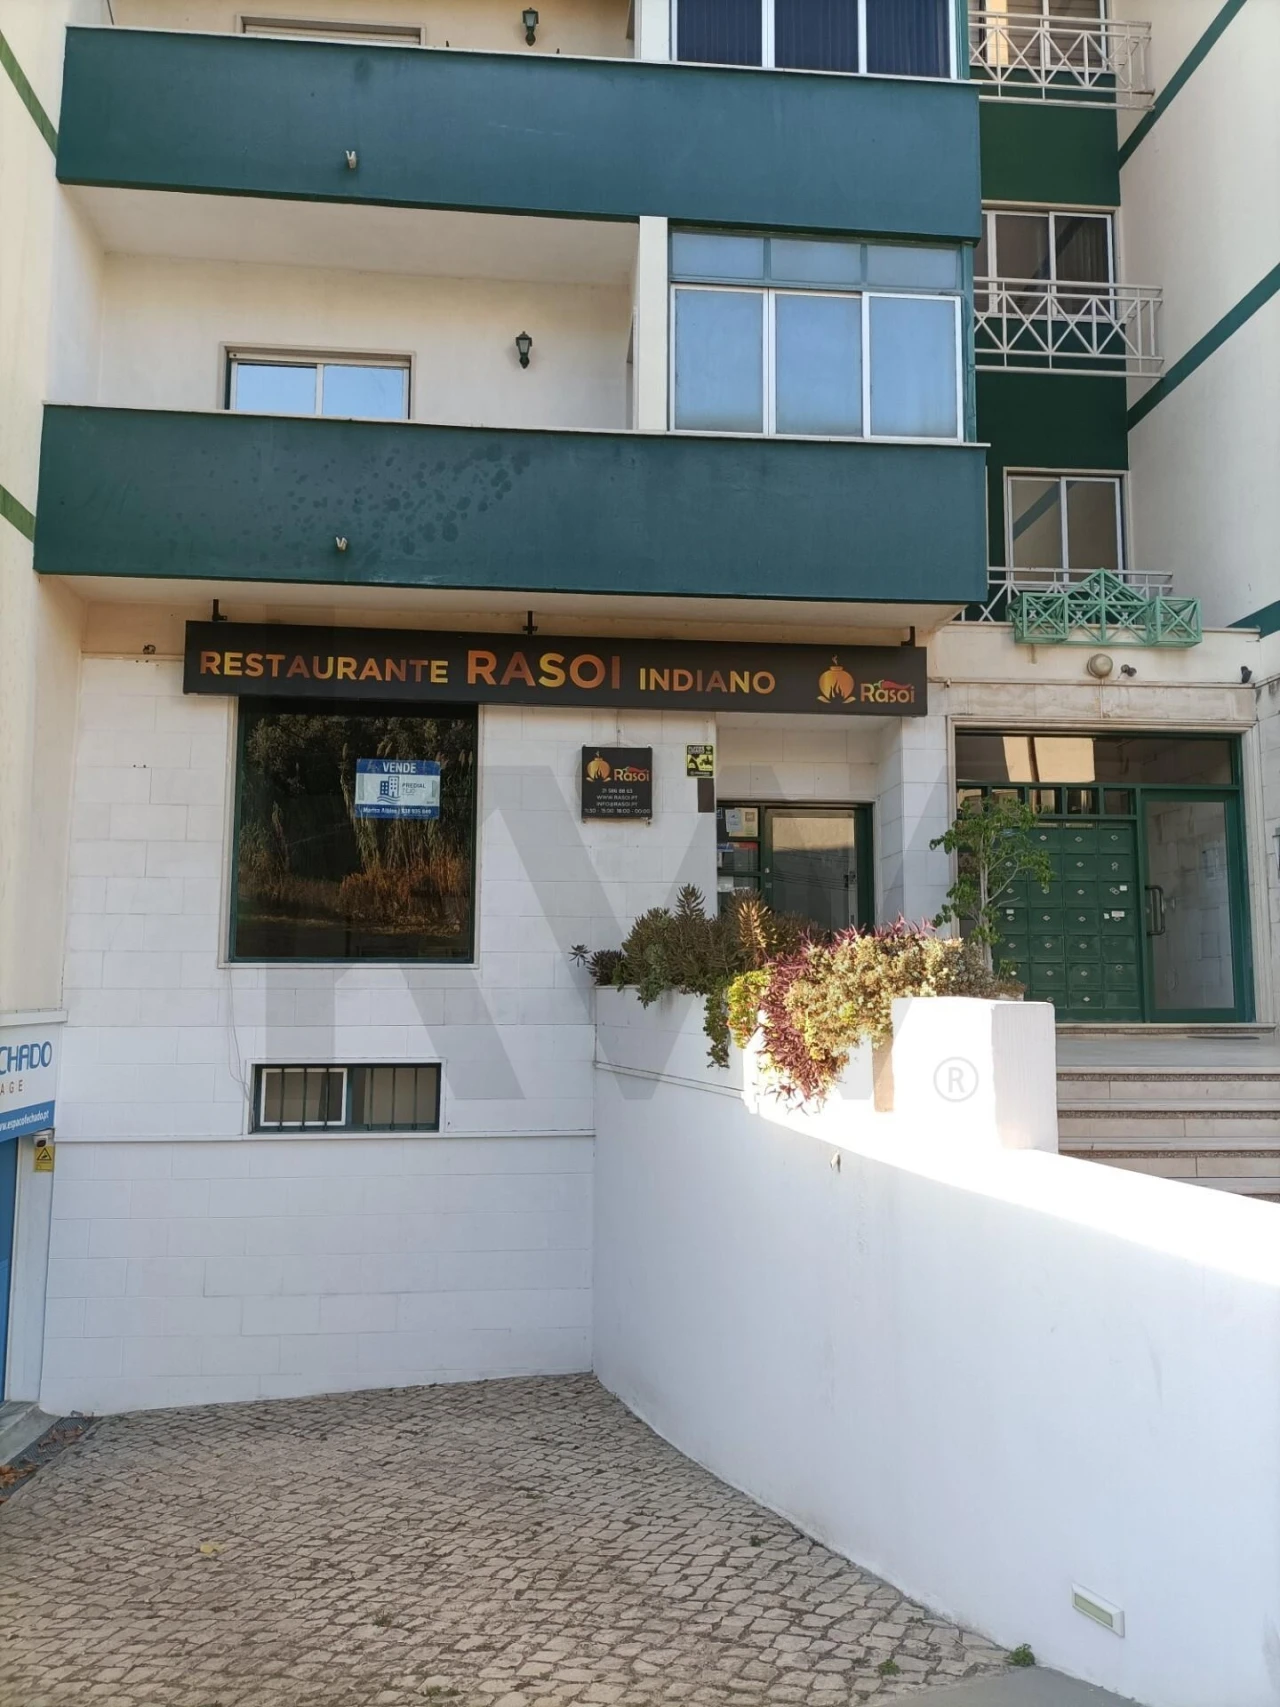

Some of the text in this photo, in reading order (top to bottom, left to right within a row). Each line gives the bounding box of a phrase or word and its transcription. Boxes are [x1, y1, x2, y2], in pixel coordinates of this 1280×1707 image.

[200, 650, 776, 694] RESTAURANTE RASOI INDIANO
[860, 683, 915, 703] Rasoi
[383, 762, 416, 773] VENDE
[613, 768, 650, 782] Rasoi
